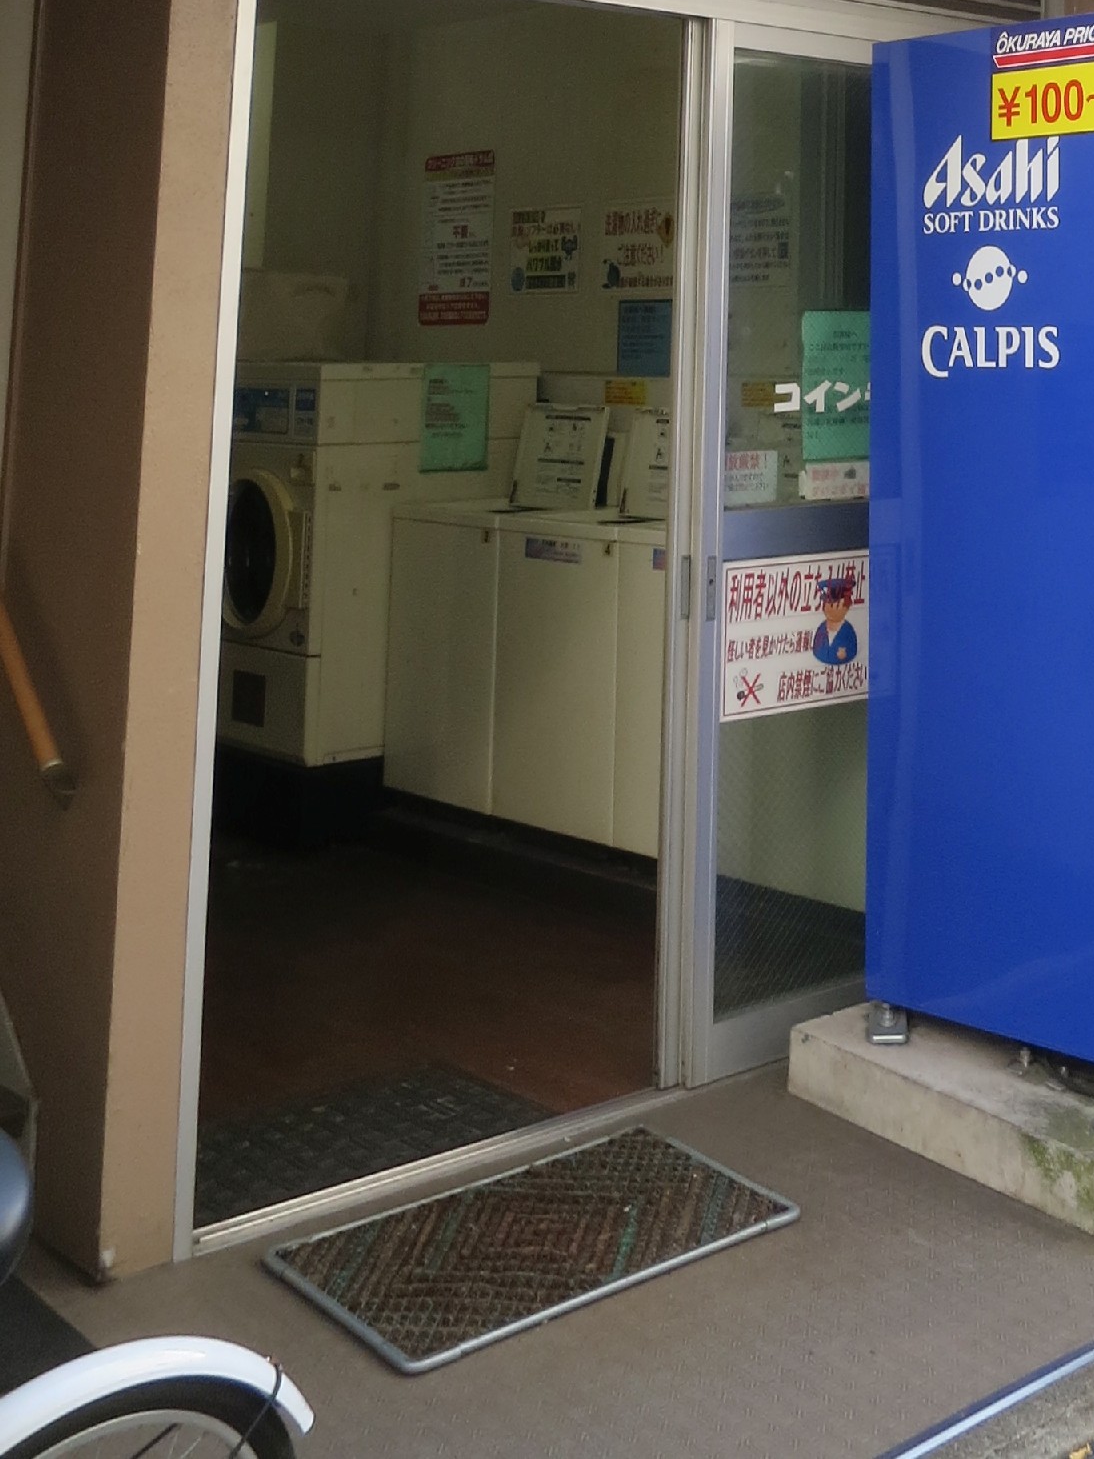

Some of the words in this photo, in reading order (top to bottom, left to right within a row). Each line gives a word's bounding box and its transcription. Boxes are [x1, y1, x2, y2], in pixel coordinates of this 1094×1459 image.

[923, 135, 1060, 209] Asahi
[923, 211, 973, 235] SOFT
[978, 206, 1060, 233] DRINKS
[921, 325, 1060, 378] CALPIS
